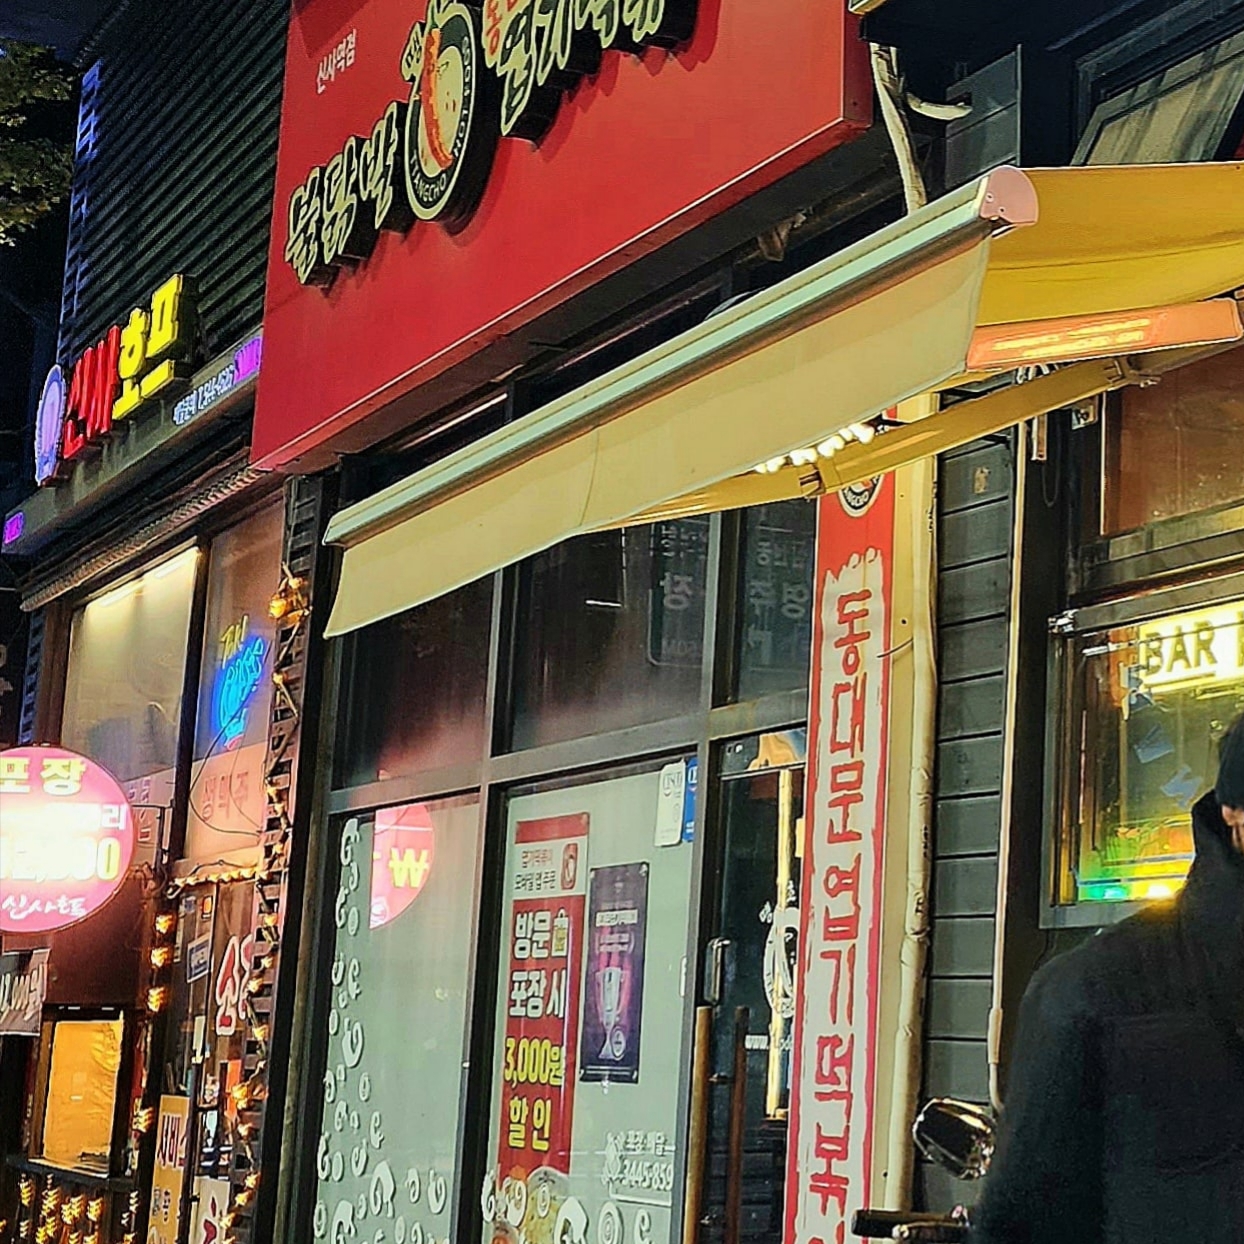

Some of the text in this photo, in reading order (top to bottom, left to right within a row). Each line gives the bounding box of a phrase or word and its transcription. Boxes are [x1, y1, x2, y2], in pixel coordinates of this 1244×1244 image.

[316, 28, 356, 95] 신사역점
[1141, 614, 1217, 678] BAR
[513, 909, 552, 960] 방문
[509, 968, 566, 1019] 포장 시
[504, 1036, 565, 1088] 3,000원
[508, 1098, 552, 1152] 할인
